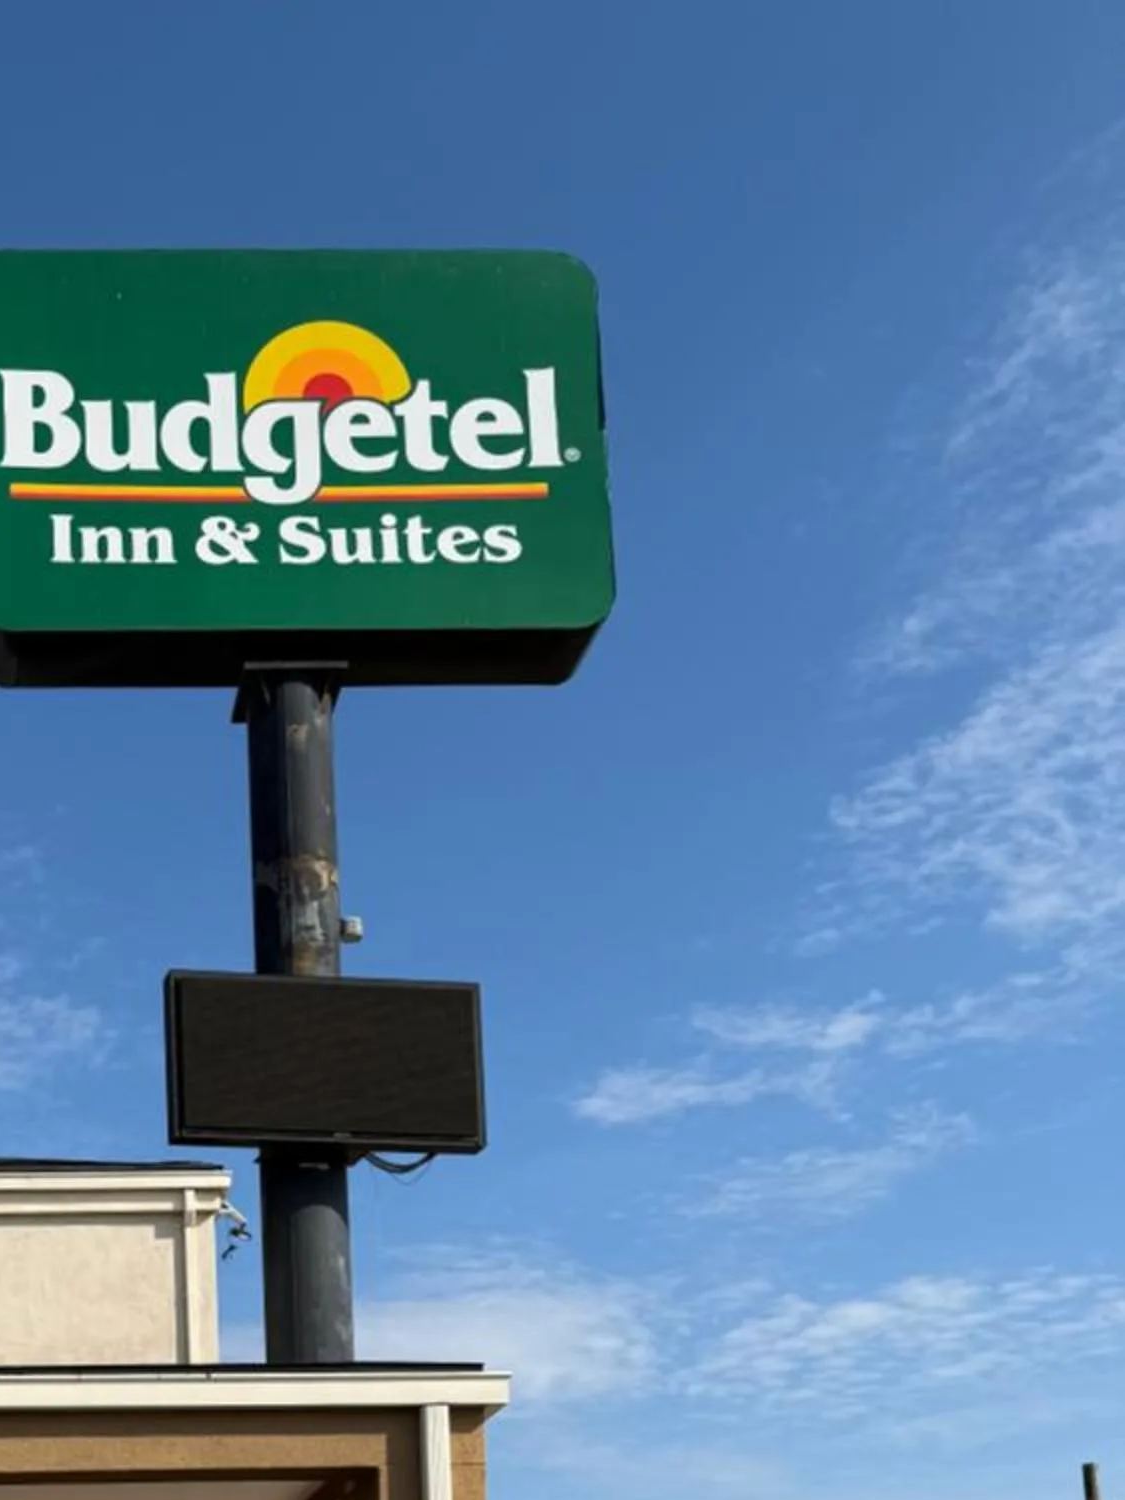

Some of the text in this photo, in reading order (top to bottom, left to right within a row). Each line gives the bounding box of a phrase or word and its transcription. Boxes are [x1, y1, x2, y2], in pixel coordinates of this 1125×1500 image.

[50, 514, 523, 564] Inn & Suites
